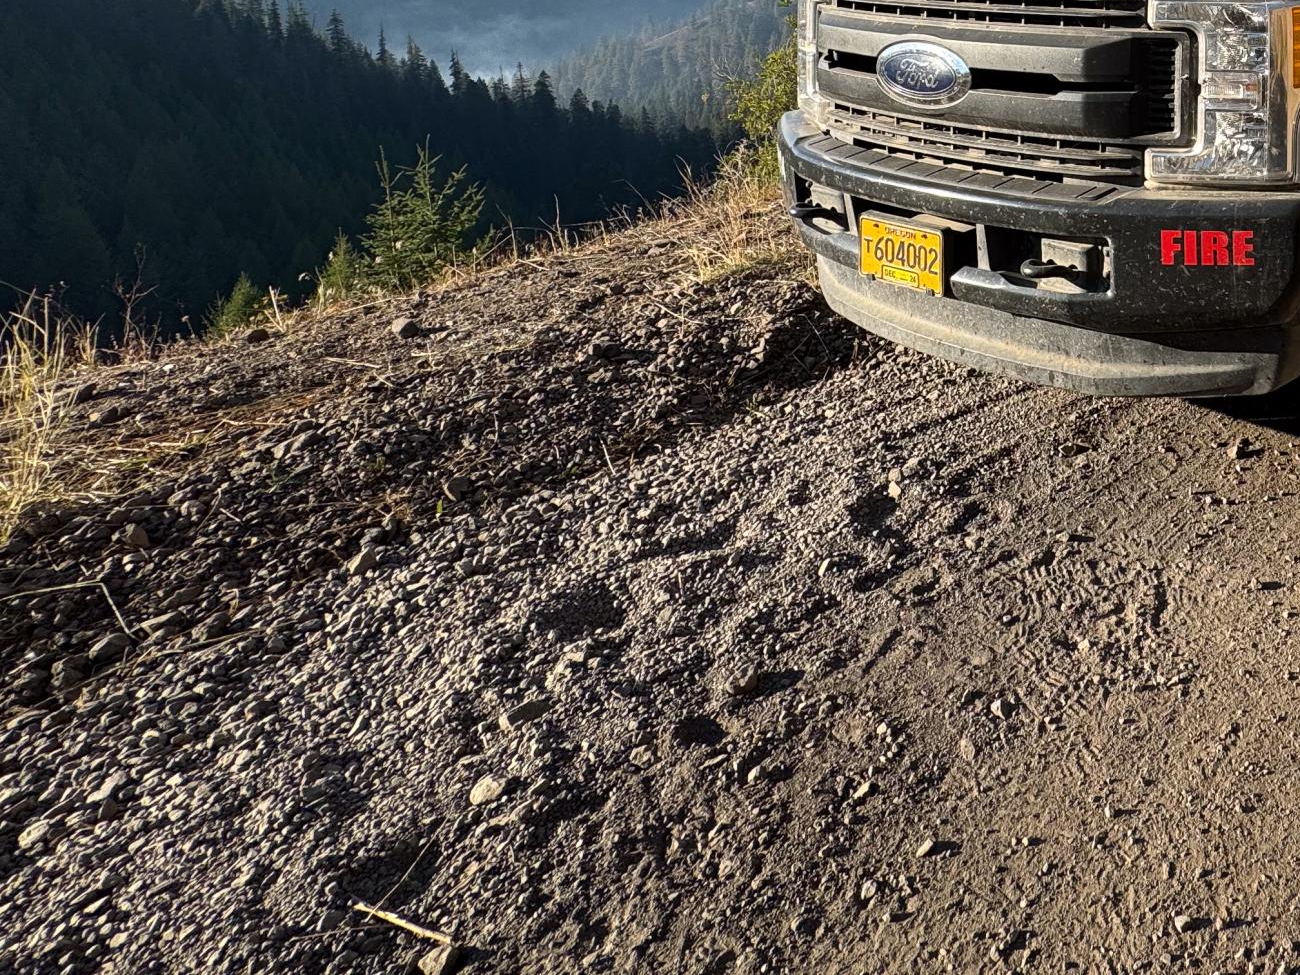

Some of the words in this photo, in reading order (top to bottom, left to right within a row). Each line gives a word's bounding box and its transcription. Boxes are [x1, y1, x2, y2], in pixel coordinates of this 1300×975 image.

[895, 58, 939, 89] Ford
[885, 227, 917, 240] OREGON
[1160, 229, 1255, 266] FIRE
